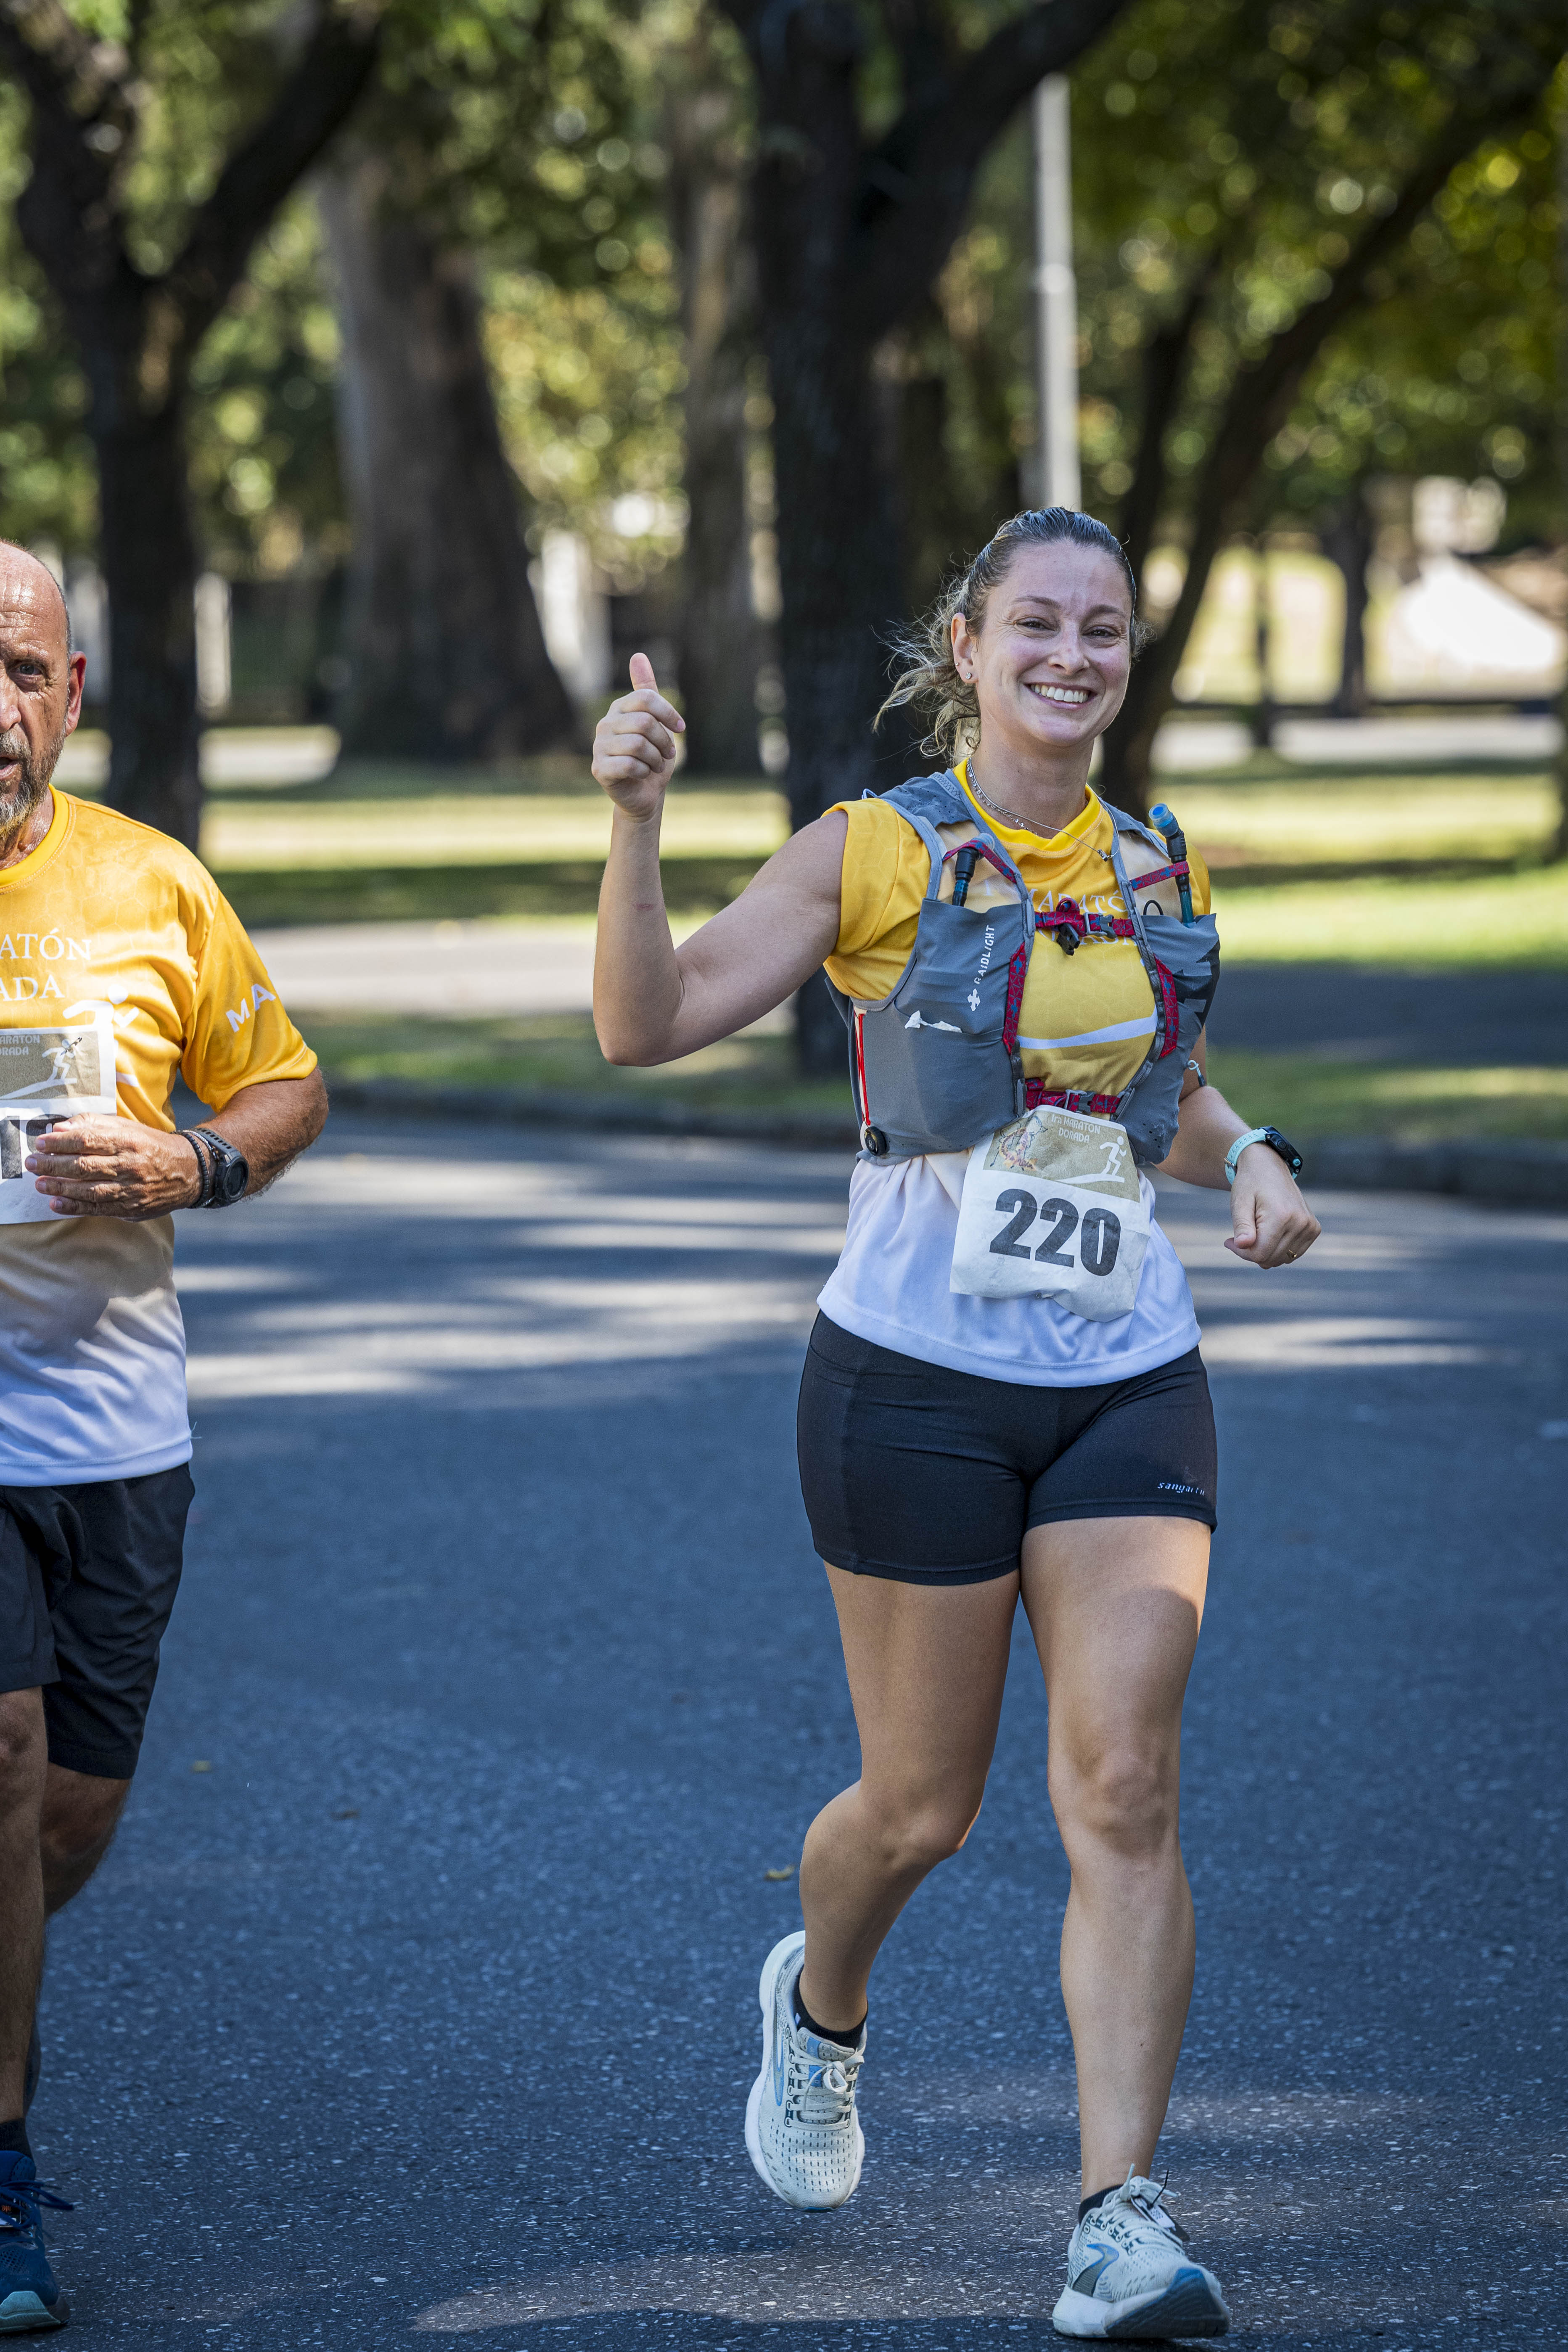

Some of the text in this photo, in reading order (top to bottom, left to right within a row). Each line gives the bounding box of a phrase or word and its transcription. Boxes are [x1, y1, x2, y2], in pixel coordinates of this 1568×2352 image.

[974, 925, 995, 984] RAIDLIGHT
[1058, 1127, 1090, 1143] DORADA
[1063, 1116, 1100, 1134] MARATON
[989, 1188, 1121, 1277] 220
